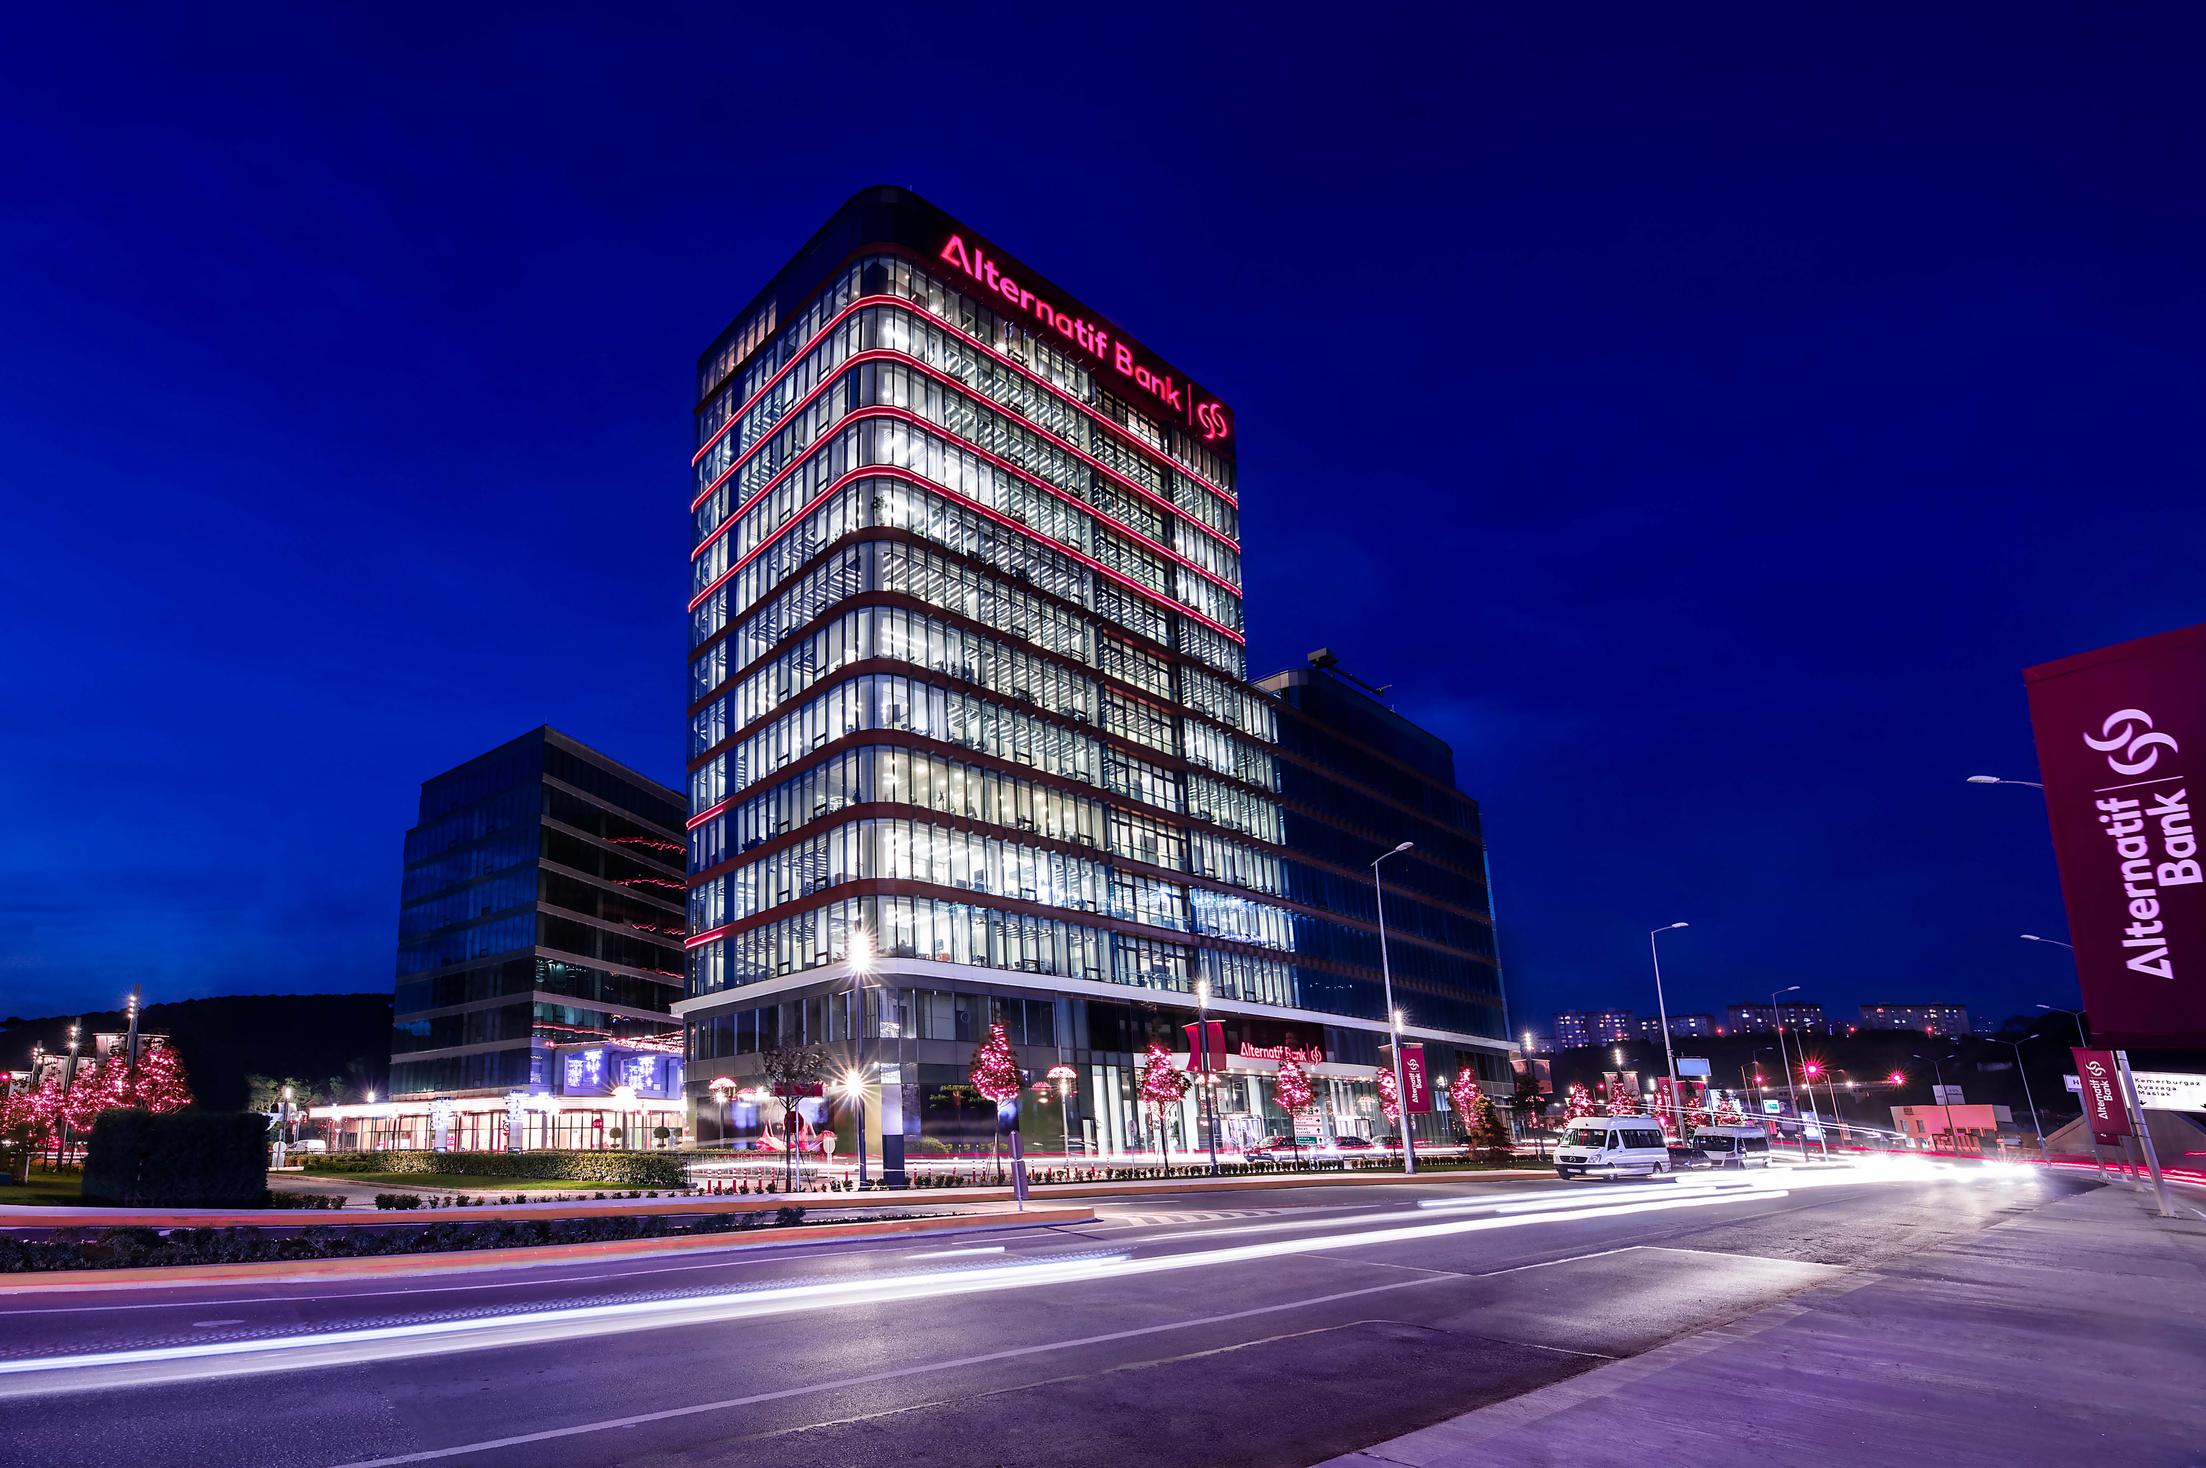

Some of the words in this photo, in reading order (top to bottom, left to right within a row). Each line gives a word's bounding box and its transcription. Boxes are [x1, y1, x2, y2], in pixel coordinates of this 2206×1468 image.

[941, 234, 1108, 360] Alternatif
[1114, 339, 1183, 412] Bank
[2144, 788, 2204, 887] Bank
[2095, 797, 2175, 980] Alternatif
[1240, 1041, 1283, 1060] Alternatif
[1284, 1046, 1307, 1062] Bank
[1408, 1072, 1419, 1104] Alternatif
[1415, 1072, 1423, 1089] Bank
[2100, 1080, 2114, 1102] Bank
[2134, 1078, 2201, 1086] Kemerburgaz
[2089, 1079, 2109, 1120] Alternatif
